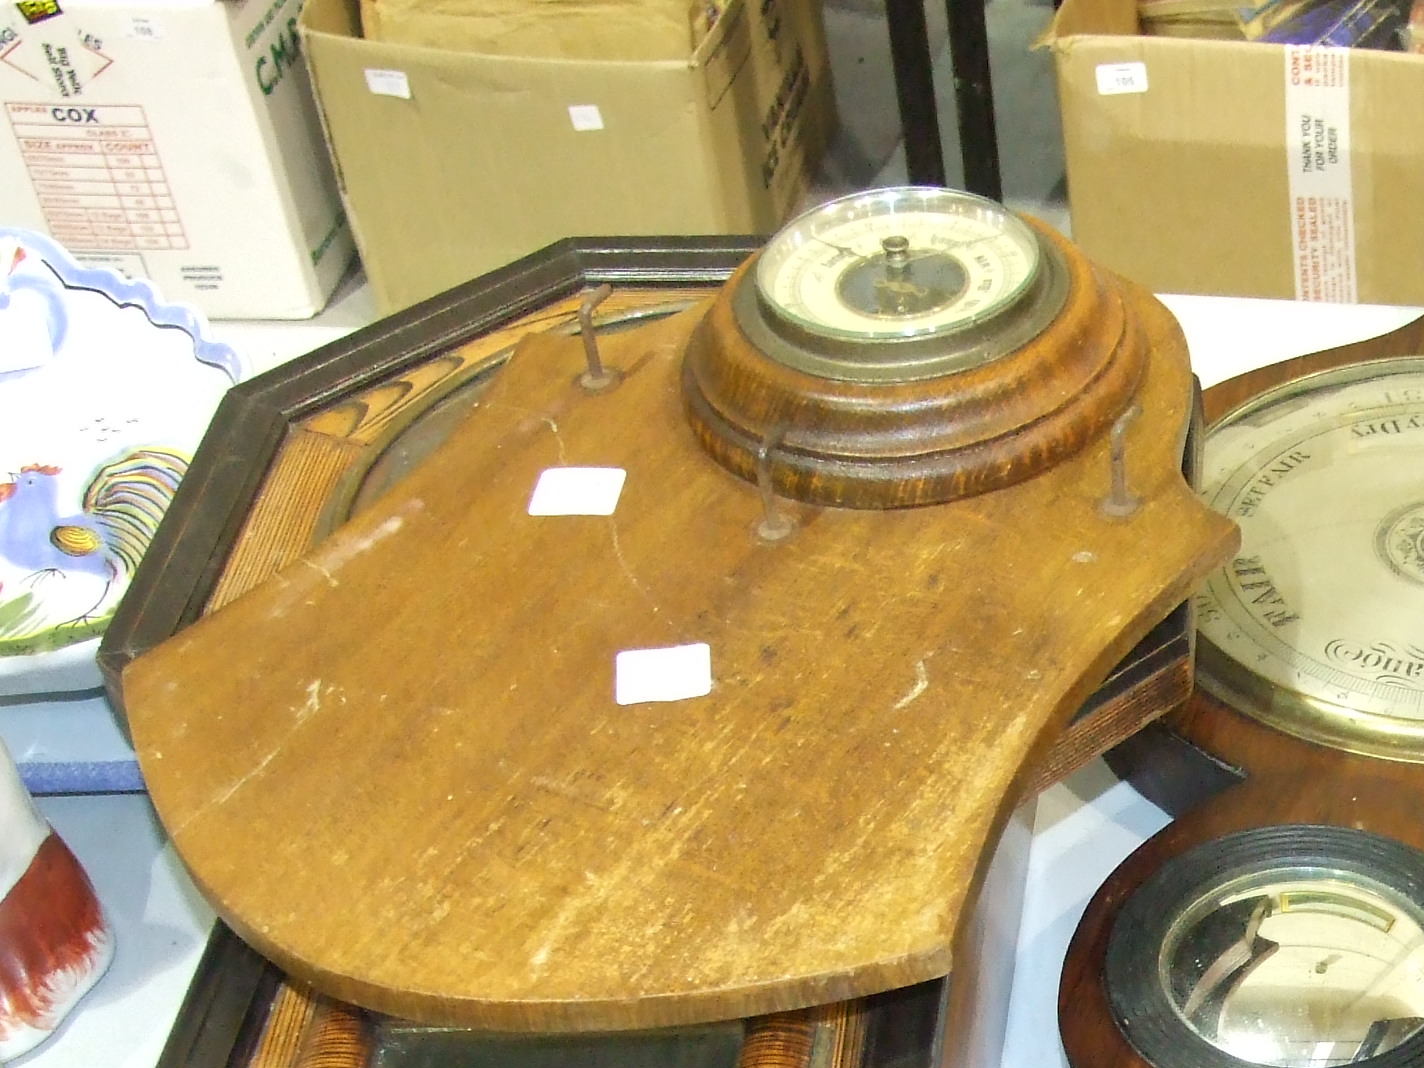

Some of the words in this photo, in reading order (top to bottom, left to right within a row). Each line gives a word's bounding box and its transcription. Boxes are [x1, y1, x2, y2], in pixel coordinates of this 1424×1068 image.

[52, 108, 99, 123] COX
[1301, 115, 1311, 137] YOU
[106, 143, 150, 152] COUNT
[1314, 119, 1324, 149] YOUR
[1327, 127, 1338, 165] ORDER
[1302, 142, 1312, 173] THANK
[1315, 151, 1325, 172] FOR
[1296, 197, 1308, 251] CHECKED
[1308, 197, 1318, 242] SEALED
[1351, 417, 1403, 440] Dry
[1233, 554, 1302, 629] FAIR
